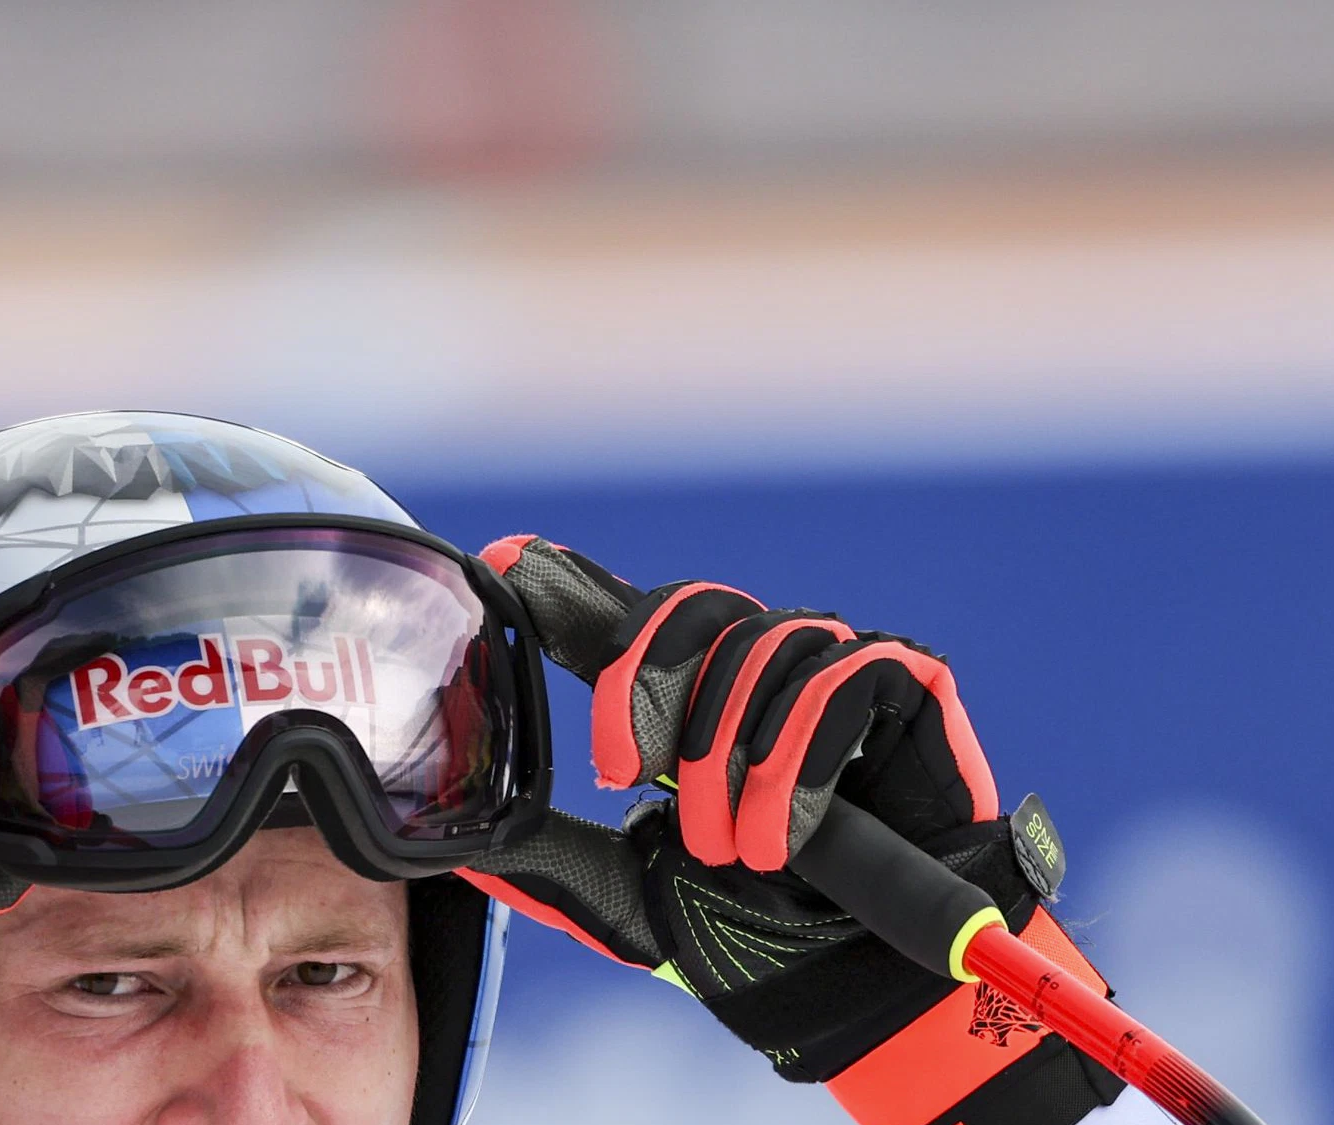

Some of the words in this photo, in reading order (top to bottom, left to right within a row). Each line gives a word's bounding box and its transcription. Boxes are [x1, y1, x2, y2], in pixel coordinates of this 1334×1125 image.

[71, 635, 234, 729] Red
[234, 634, 376, 705] Bull
[177, 744, 234, 780] swi
[1026, 821, 1055, 869] SIZE
